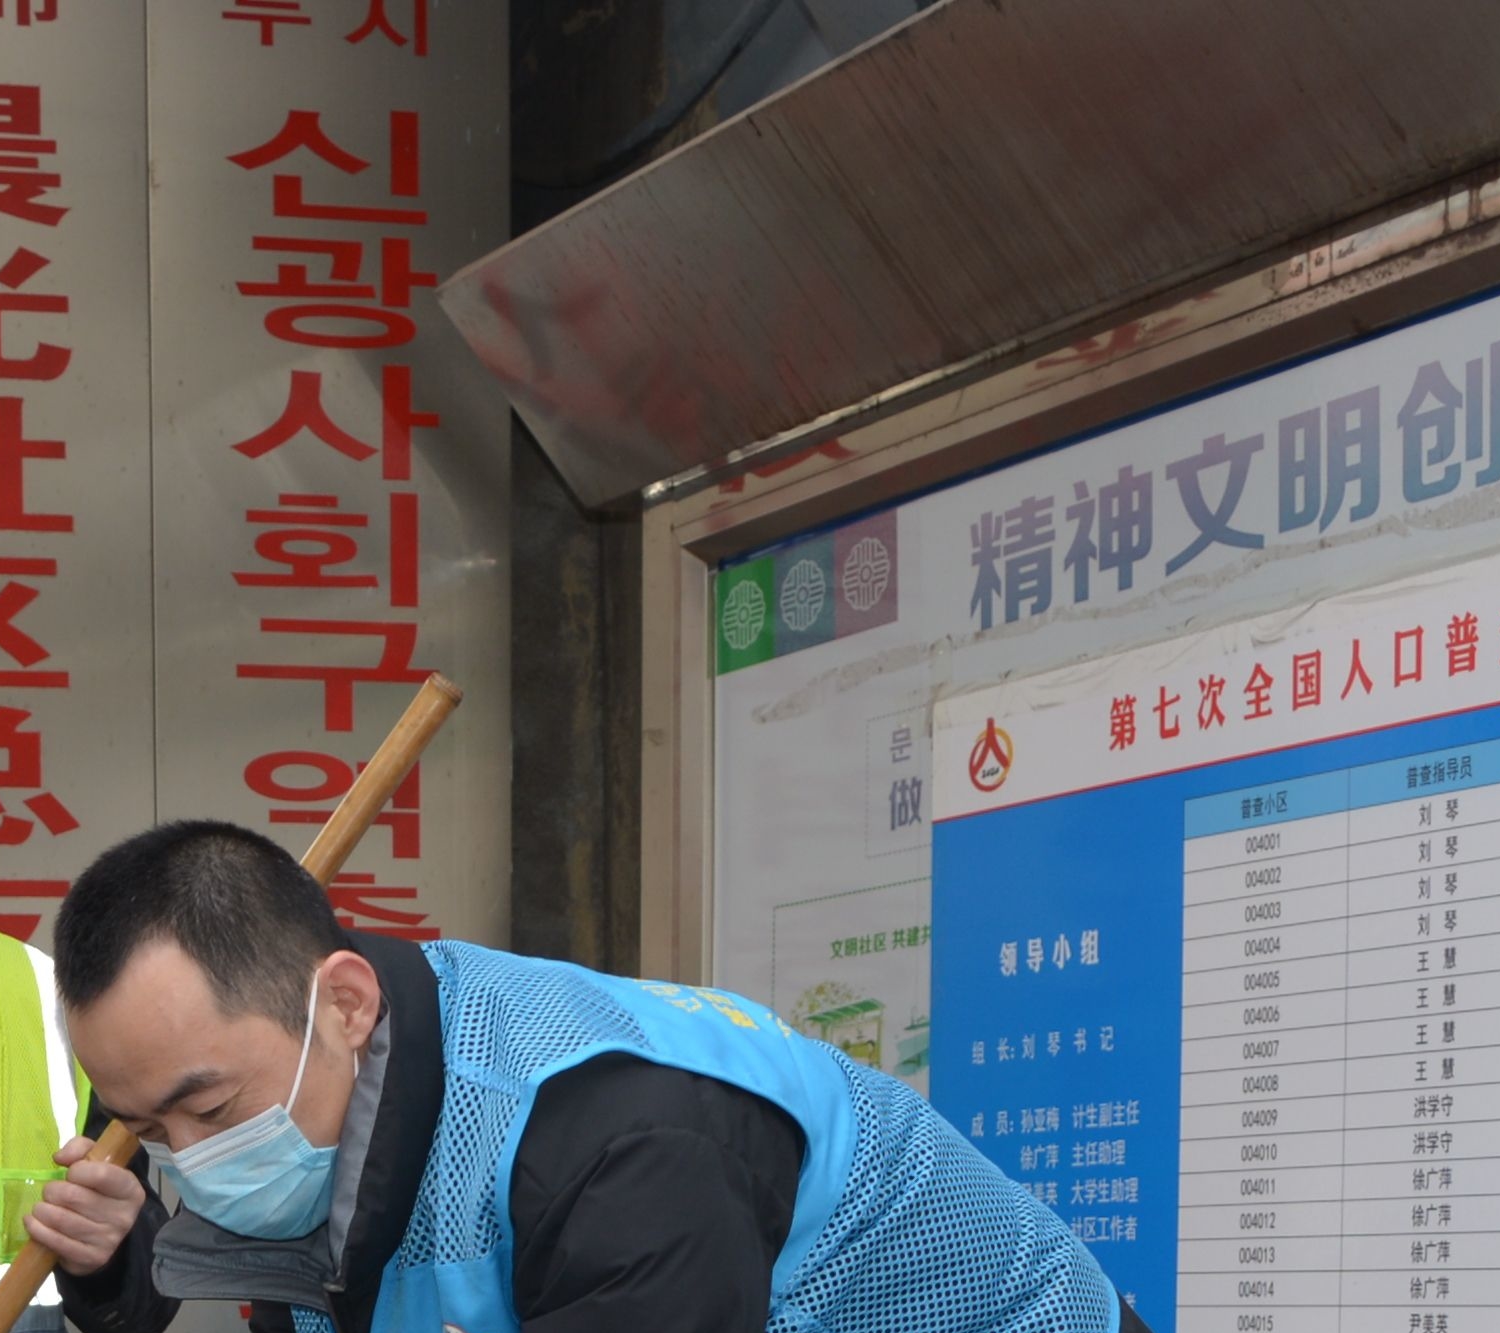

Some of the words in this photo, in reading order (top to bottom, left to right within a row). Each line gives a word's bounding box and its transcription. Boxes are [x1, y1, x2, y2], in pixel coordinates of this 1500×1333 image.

[1241, 789, 1288, 820] 普查小区
[1406, 755, 1473, 790] 普查指导员
[1245, 833, 1281, 855] 004001
[1244, 867, 1281, 889] 004002
[1244, 901, 1281, 923] 004003
[829, 931, 887, 960] 文明社区
[999, 929, 1100, 978] 领导小组
[1244, 936, 1281, 958] 004004
[1243, 970, 1280, 992] 004005
[1243, 1004, 1280, 1026] 004006
[1242, 1039, 1279, 1061] 004007
[1242, 1074, 1279, 1094] 004008
[1072, 1099, 1140, 1128] 计生副主任
[1241, 1108, 1279, 1128] 004009
[1413, 1094, 1454, 1118] 洪学守
[1020, 1145, 1059, 1170] 徐广萍
[1072, 1140, 1126, 1168] 主任助理
[1240, 1142, 1278, 1163] 004010
[1412, 1130, 1453, 1155] 洪学守
[1070, 1177, 1139, 1205] 大学生助理
[1240, 1177, 1276, 1197] 004011
[1412, 1167, 1453, 1191] 徐广萍
[1239, 1211, 1277, 1230] 004012
[1411, 1203, 1452, 1227] 徐广萍
[1238, 1245, 1276, 1265] 004013
[1410, 1240, 1451, 1264] 徐广萍
[1238, 1280, 1275, 1298] 004014
[1409, 1276, 1450, 1300] 徐广萍
[1237, 1314, 1274, 1333] 004015
